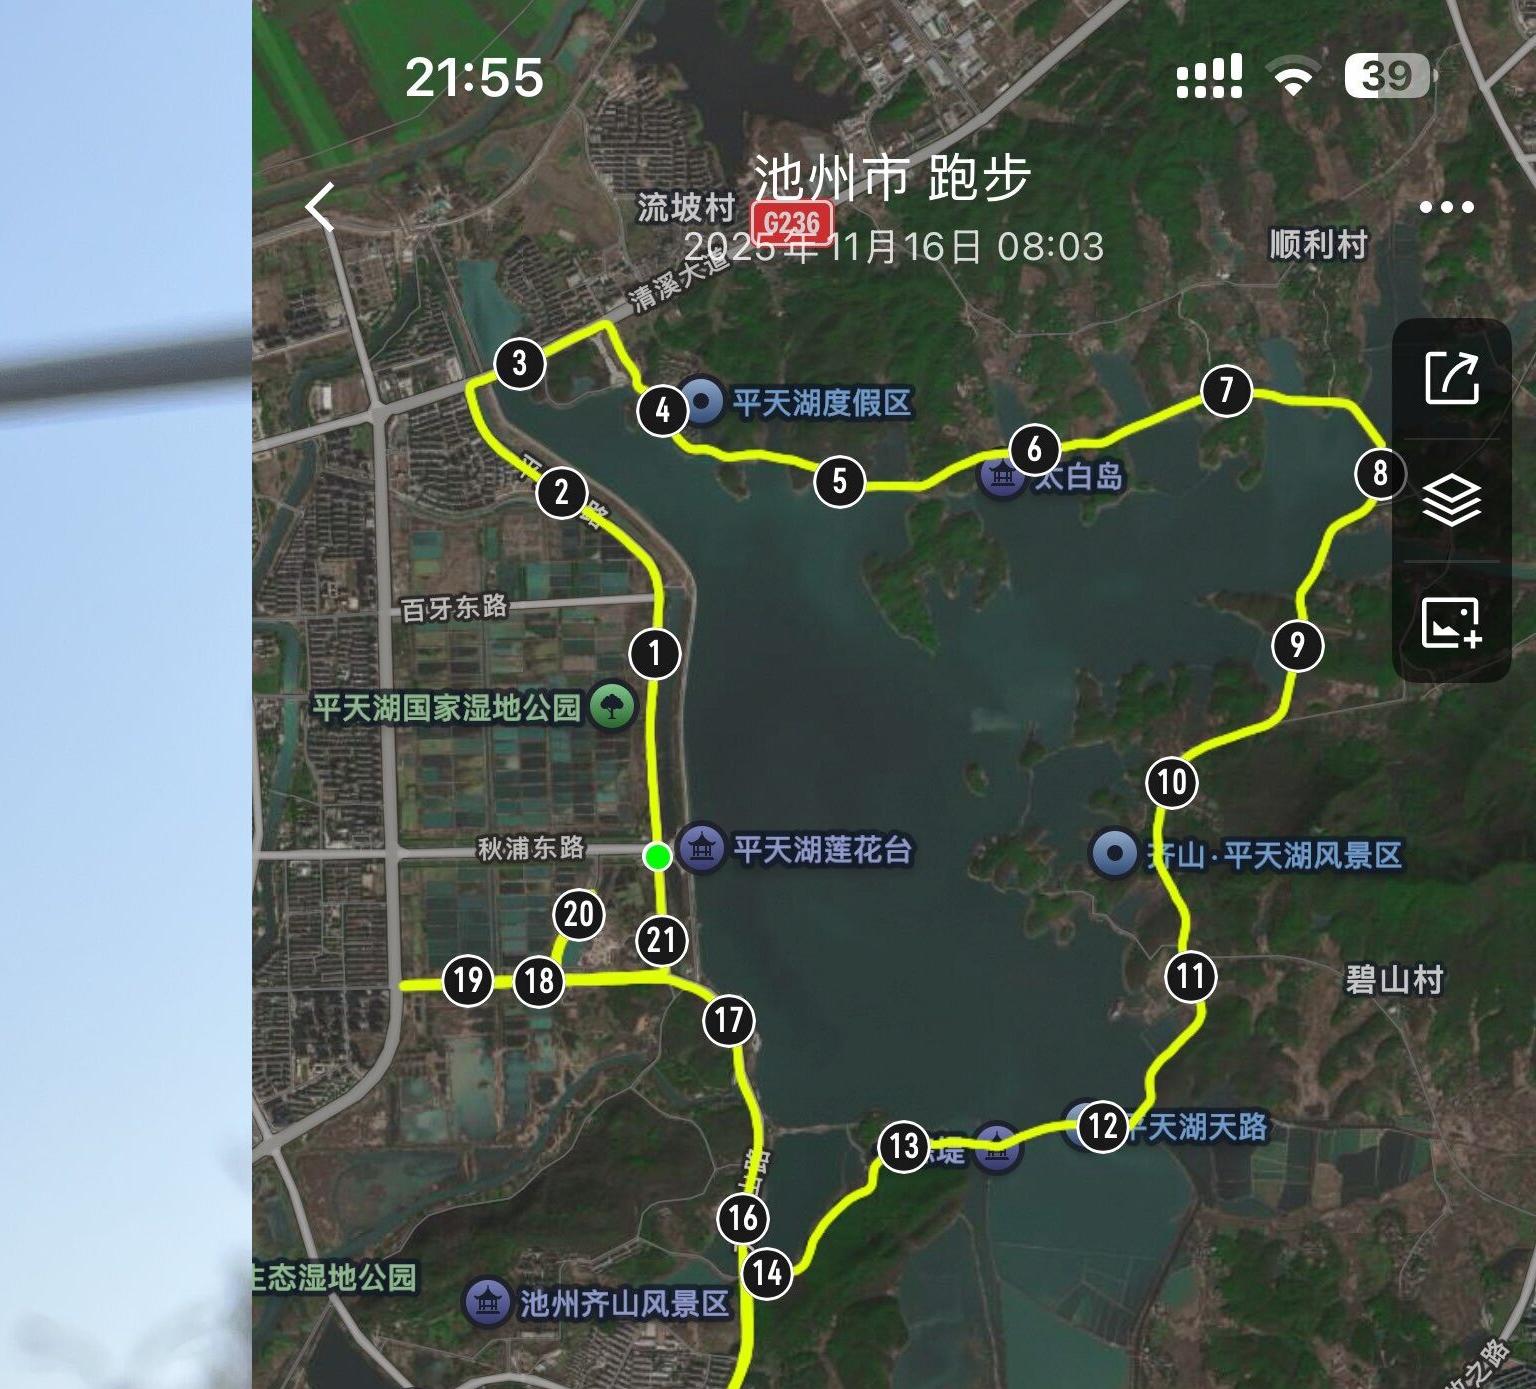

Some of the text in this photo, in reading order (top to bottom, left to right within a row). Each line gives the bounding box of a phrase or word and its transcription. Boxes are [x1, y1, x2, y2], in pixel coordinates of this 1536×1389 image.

[405, 56, 545, 98] 21:55
[1361, 59, 1413, 93] 39
[754, 152, 1033, 203] 池州市 跑步
[637, 191, 736, 223] 流坡村
[763, 209, 821, 236] G236
[684, 229, 1105, 265] 2025年11月16日 08:03
[1269, 228, 1368, 261] 顺利村
[628, 246, 731, 314] 清溪大道
[512, 349, 528, 377] 3
[733, 386, 911, 417] 平天湖度假区
[1220, 378, 1235, 404] 7
[655, 397, 671, 421] 4
[1027, 437, 1042, 462] 6
[831, 468, 848, 493] 5
[1036, 461, 1123, 493] 太白岛
[1372, 461, 1389, 485] 8
[554, 479, 570, 505] 2
[400, 592, 508, 624] 百牙东路
[1290, 633, 1306, 658] 9
[313, 693, 582, 724] 平天湖国家湿地公园
[1157, 769, 1188, 796] 10
[478, 835, 585, 862] 秋浦东路
[733, 835, 912, 865] 平天湖莲花台
[562, 900, 594, 928] 20
[645, 926, 675, 953] 21
[452, 966, 484, 994] 19
[523, 968, 555, 996] 18
[1176, 962, 1205, 990] 11
[1345, 964, 1445, 996] 碧山村
[714, 1007, 744, 1034] 17
[1087, 1111, 1119, 1140] 12
[889, 1131, 919, 1160] 13
[728, 1203, 758, 1231] 16
[749, 1259, 783, 1287] 14
[520, 1289, 731, 1319] 池州齐山风景区
